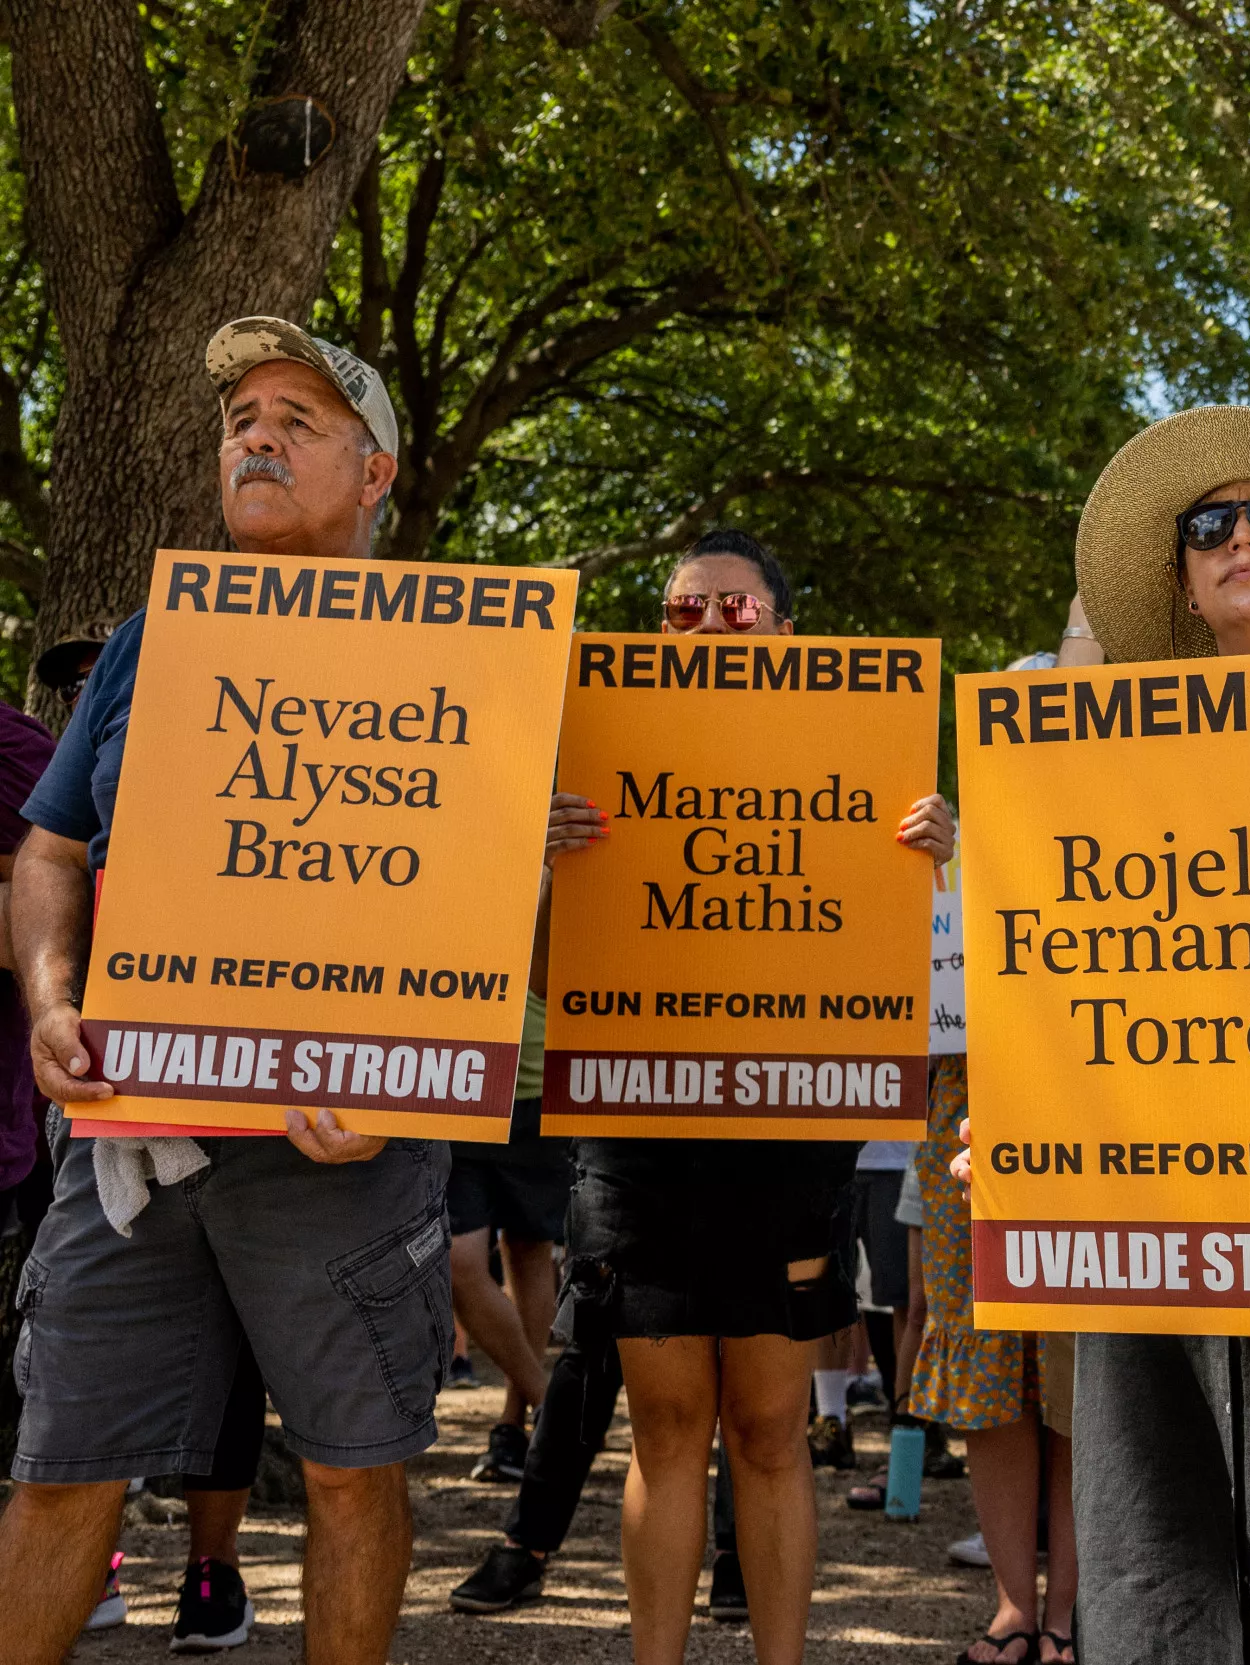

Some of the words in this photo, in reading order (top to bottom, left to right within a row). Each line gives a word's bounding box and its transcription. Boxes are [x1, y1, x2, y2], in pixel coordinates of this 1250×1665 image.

[165, 562, 555, 630] REMEMBER
[578, 643, 925, 693] REMEMBER
[206, 676, 470, 745] Nevaeh
[216, 740, 442, 827] Alyssa
[614, 771, 878, 824] Maranda
[217, 819, 420, 886] Bravo
[683, 827, 805, 876] Gail
[641, 882, 843, 933] Mathis
[107, 952, 197, 984] GUN
[210, 957, 384, 994] REFORM
[398, 967, 509, 1002] NOW!
[562, 991, 641, 1016] GUN
[655, 992, 806, 1020] REFORM
[820, 994, 914, 1021] NOW!
[102, 1030, 282, 1090] UVALDE
[290, 1040, 486, 1102] STRONG
[569, 1058, 724, 1104] UVALDE
[734, 1061, 901, 1108] STRONG
[991, 1142, 1083, 1176] GUN
[1005, 1230, 1190, 1291] UVALDE
